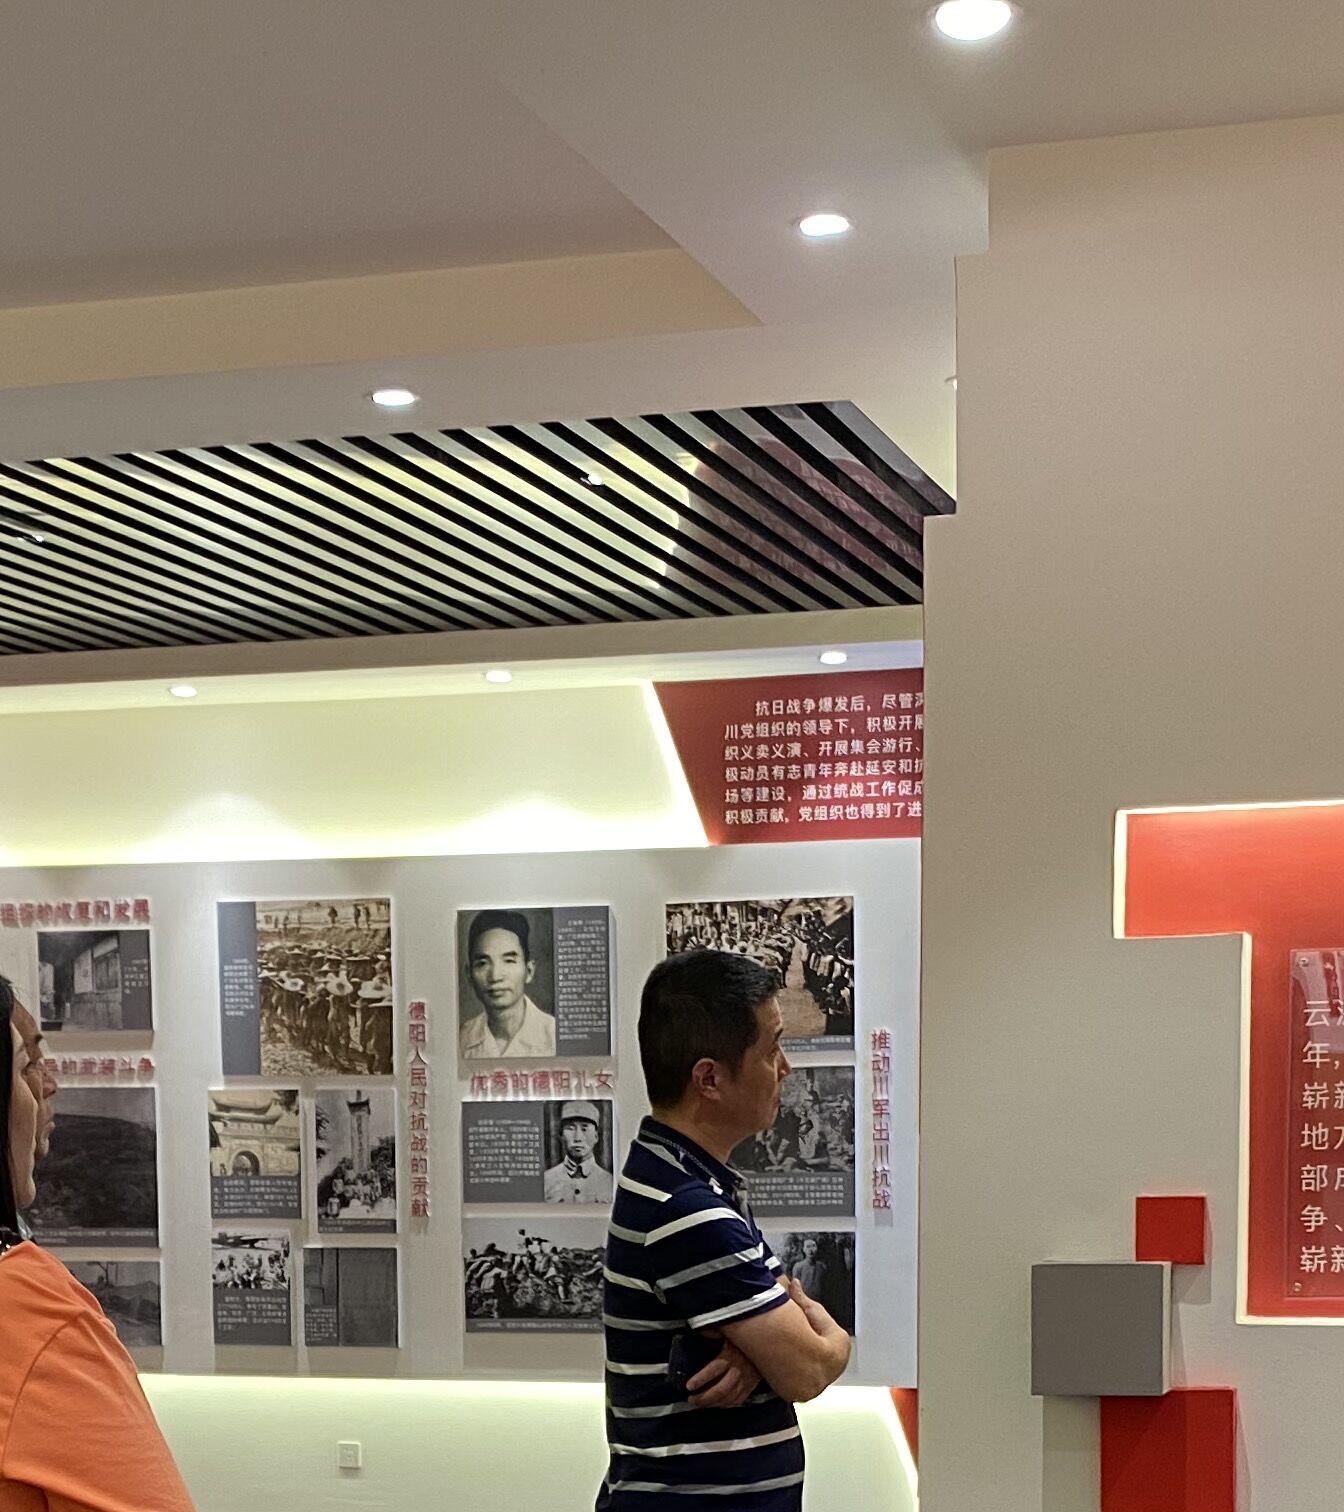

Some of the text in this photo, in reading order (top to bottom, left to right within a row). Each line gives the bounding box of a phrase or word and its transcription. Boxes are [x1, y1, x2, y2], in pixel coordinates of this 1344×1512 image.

[407, 1000, 430, 1218] 德阳人民对抗战的贡献
[471, 1070, 614, 1091] 优秀的德阳儿女
[871, 1029, 892, 1210] 推动川军出川抗战
